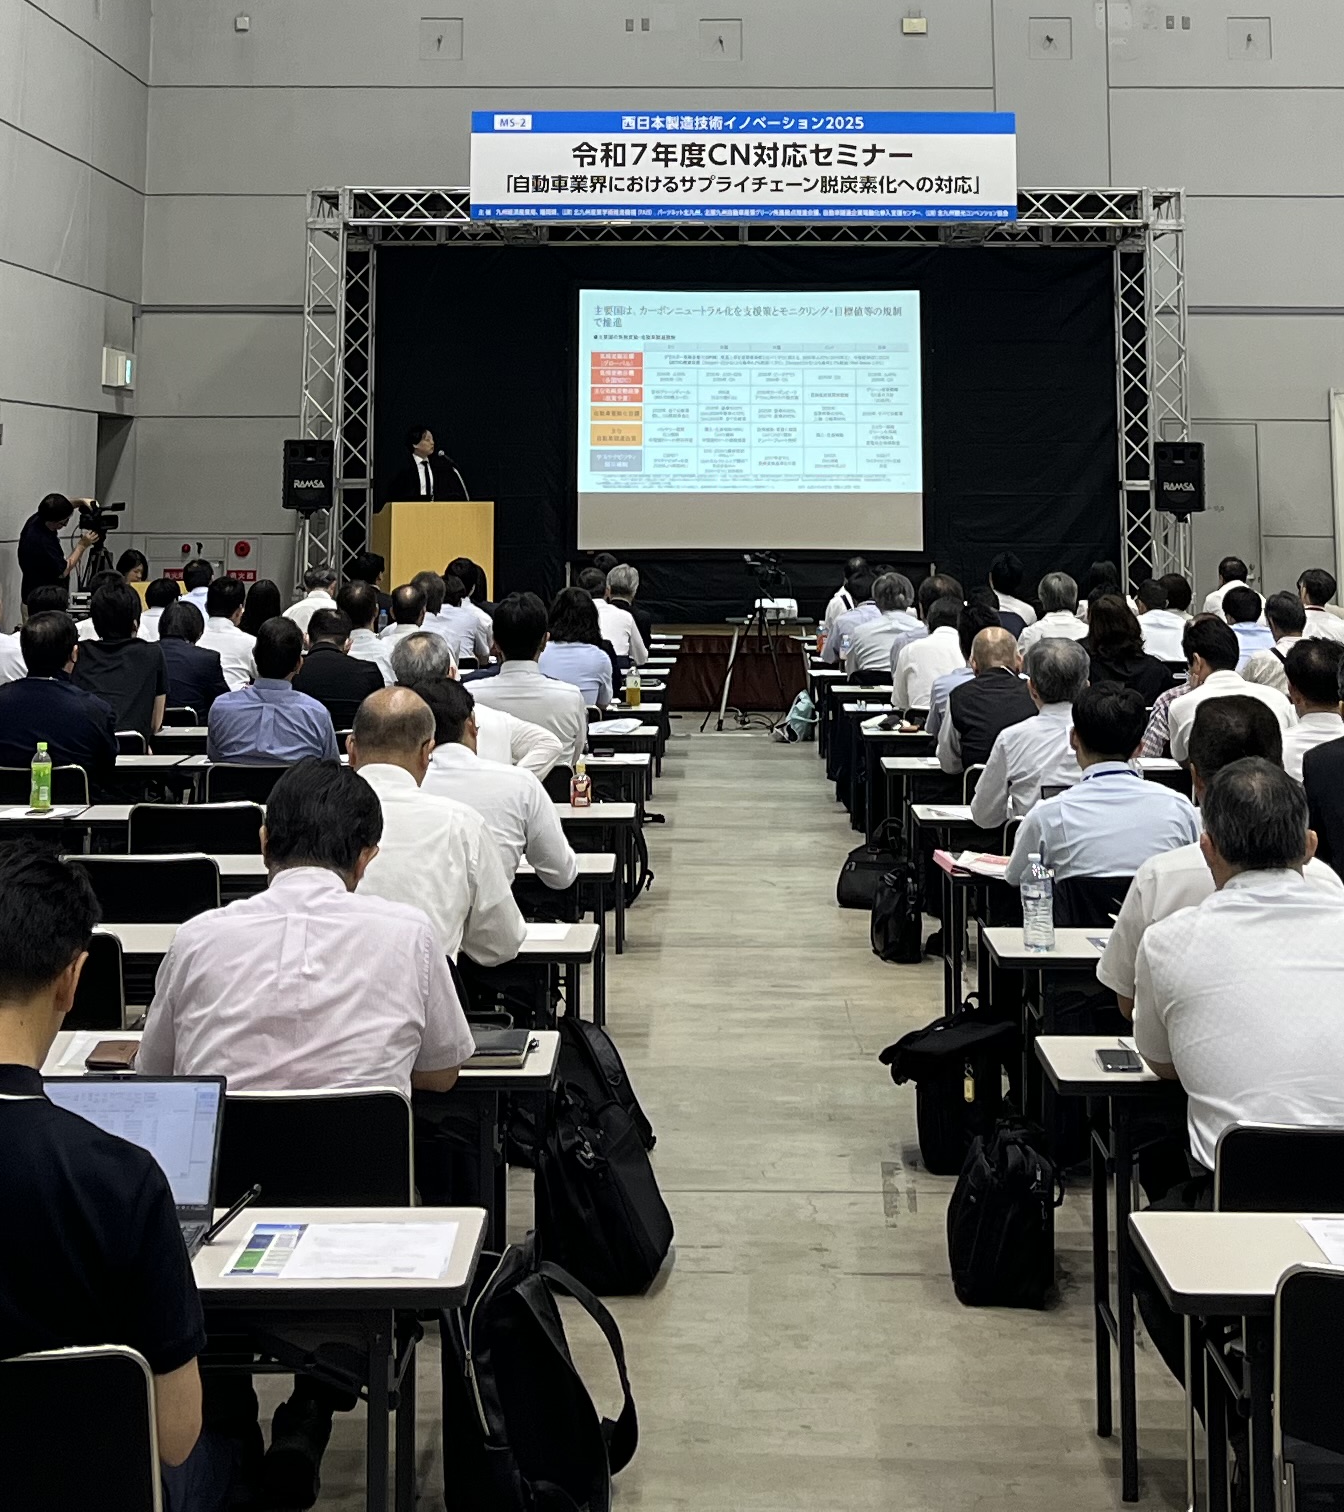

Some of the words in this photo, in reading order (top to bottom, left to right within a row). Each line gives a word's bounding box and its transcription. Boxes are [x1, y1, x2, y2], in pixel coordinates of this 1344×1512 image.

[499, 118, 526, 128] MS-2
[621, 115, 865, 131] 西日本製造技術イノベーション2025
[571, 141, 914, 169] 令和7年度CN対応セミナー
[505, 174, 981, 195] 「自動車業界におけるサプライチェーン脱炭素化への対応」
[293, 479, 325, 489] RAMSA
[1163, 482, 1196, 491] RAMSA
